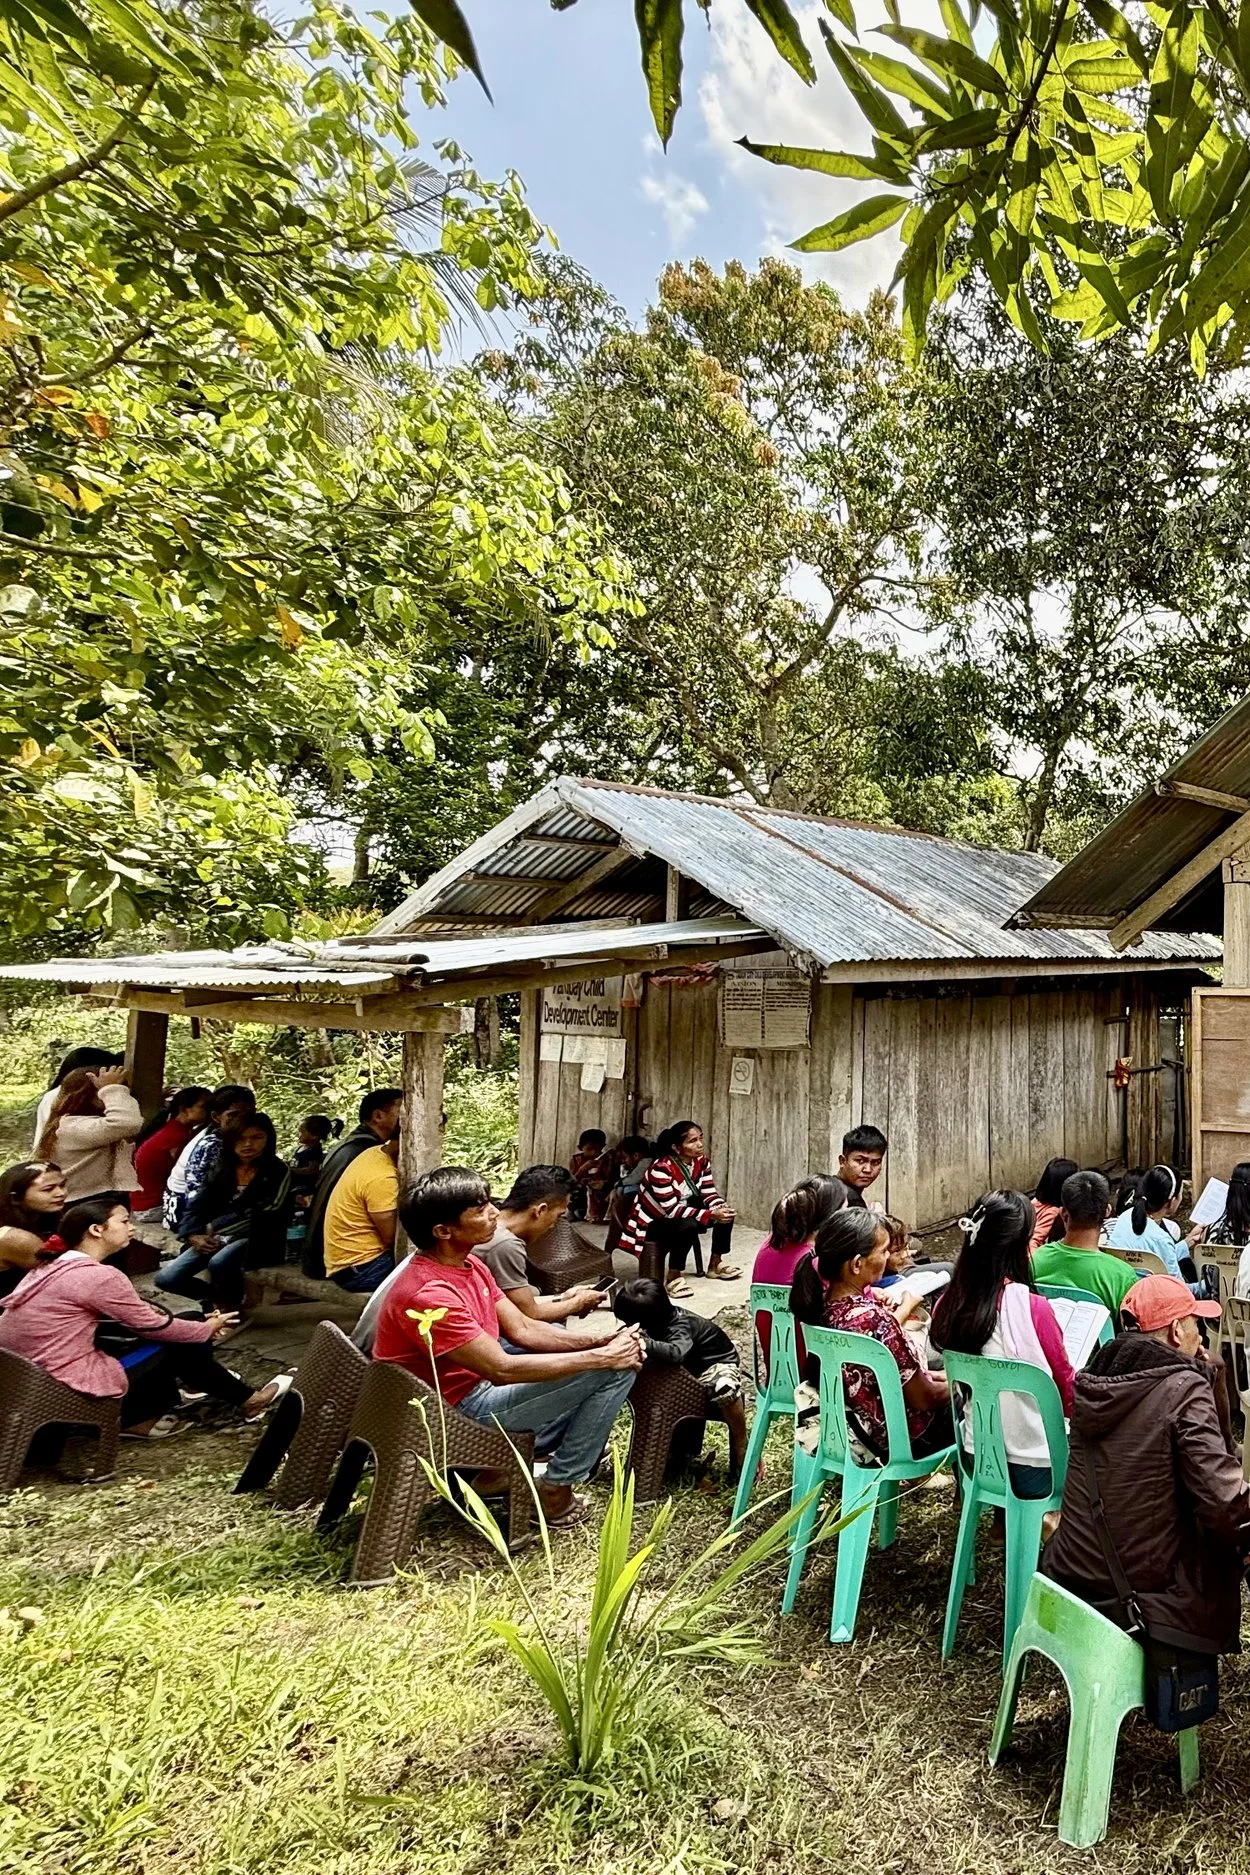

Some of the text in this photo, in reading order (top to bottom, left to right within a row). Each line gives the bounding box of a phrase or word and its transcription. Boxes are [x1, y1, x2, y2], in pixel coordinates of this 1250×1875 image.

[544, 1001, 619, 1030] Development Center
[1179, 1685, 1204, 1712] CAT
